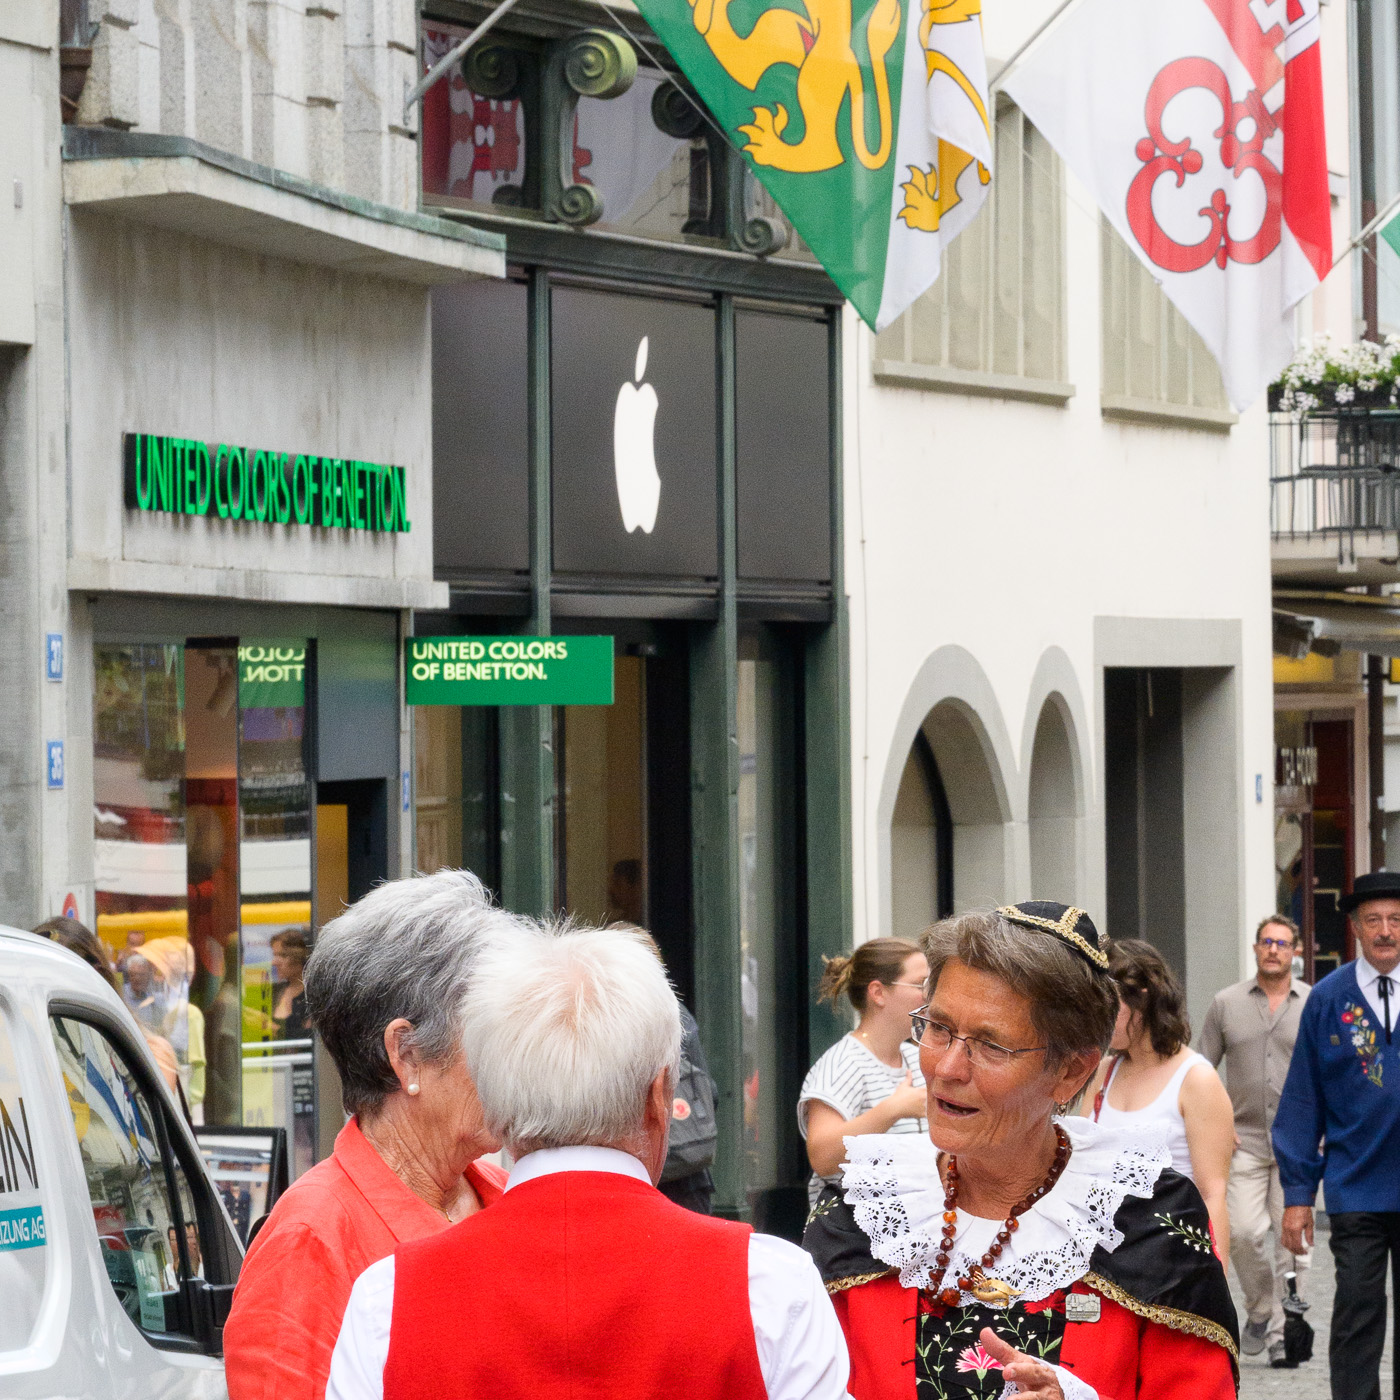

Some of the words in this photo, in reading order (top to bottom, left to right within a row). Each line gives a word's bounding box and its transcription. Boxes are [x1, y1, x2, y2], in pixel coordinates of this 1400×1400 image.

[136, 433, 211, 515] UNITED
[215, 443, 291, 524] COLORS
[293, 454, 318, 525] OF
[412, 641, 485, 660] UNITED
[488, 641, 568, 660] COLORS
[412, 662, 440, 681] OF
[443, 662, 548, 681] BENETTON.
[32, 1216, 46, 1241] AG
